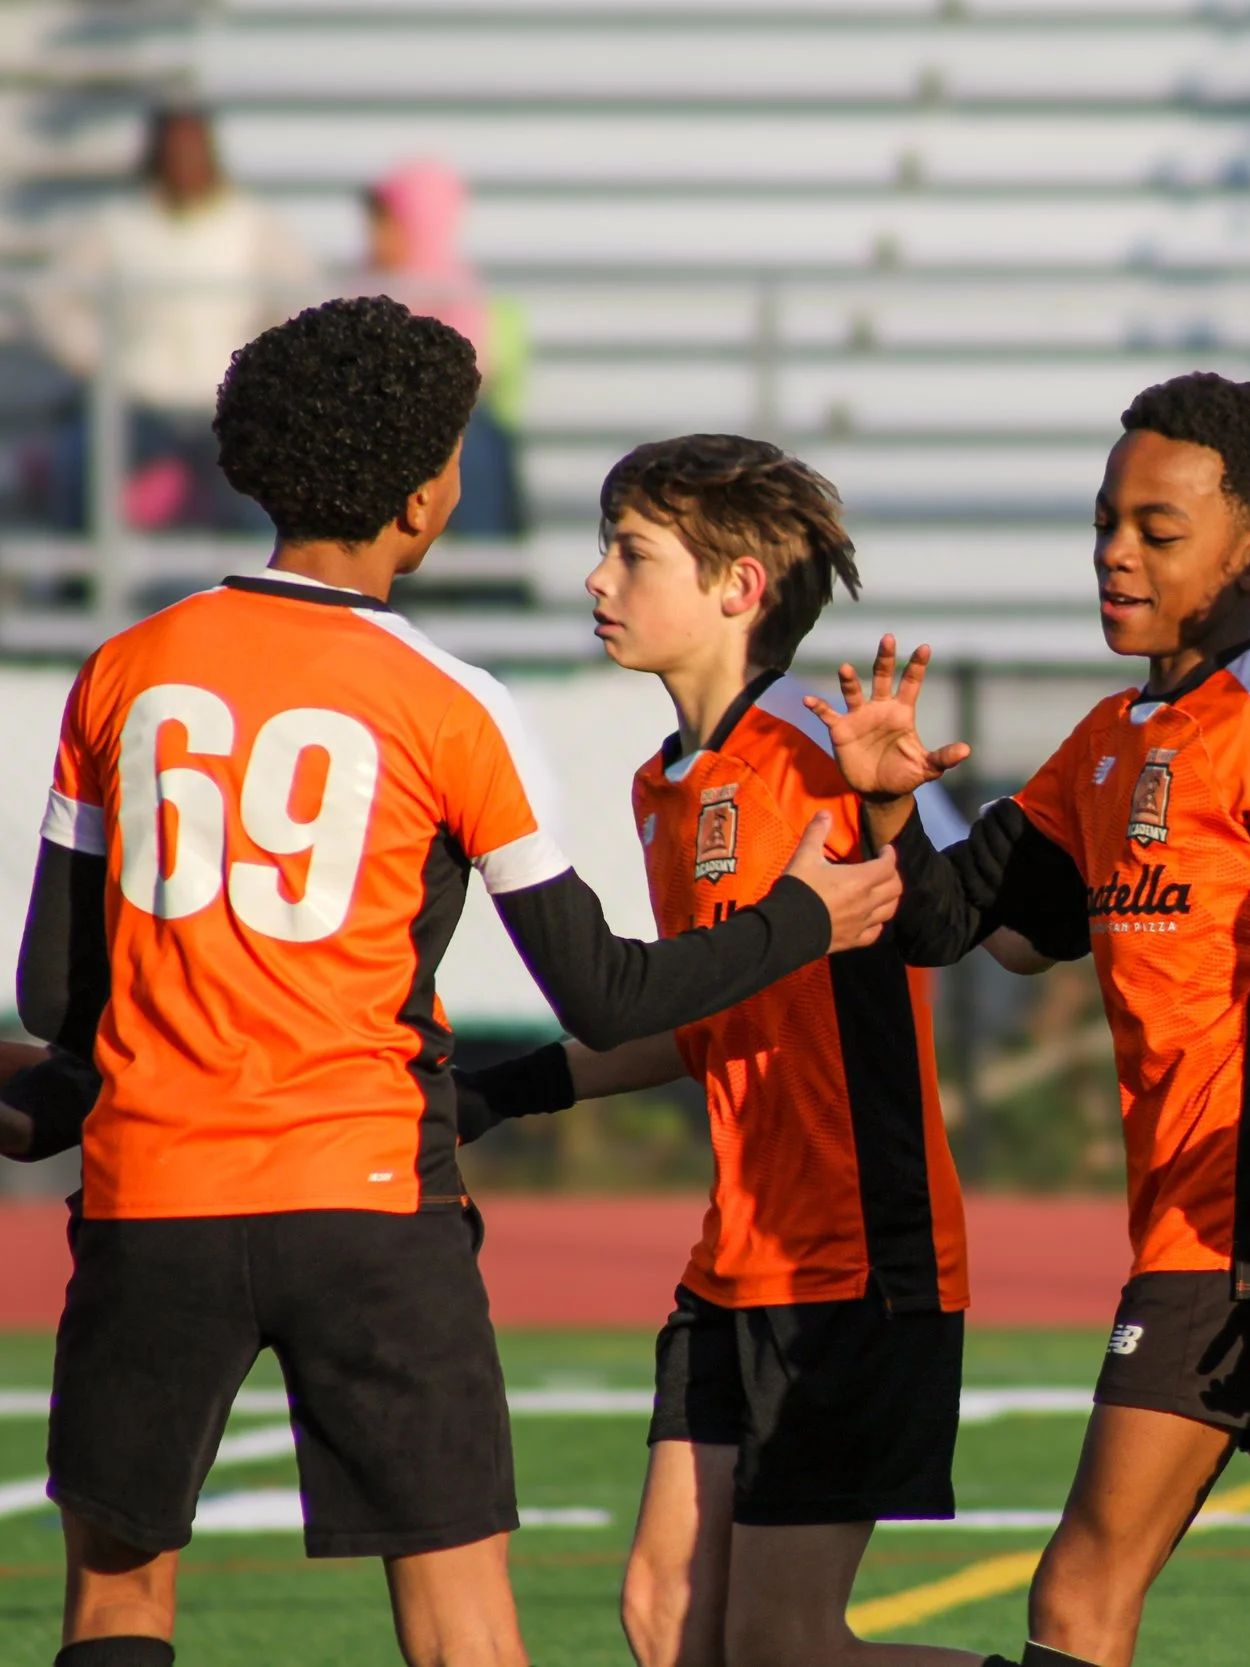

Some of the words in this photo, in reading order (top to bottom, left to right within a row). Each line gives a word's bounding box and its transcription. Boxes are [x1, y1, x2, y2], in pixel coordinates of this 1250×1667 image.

[117, 683, 378, 943] 69
[1087, 864, 1192, 915] atella
[1133, 921, 1177, 933] PIZZA
